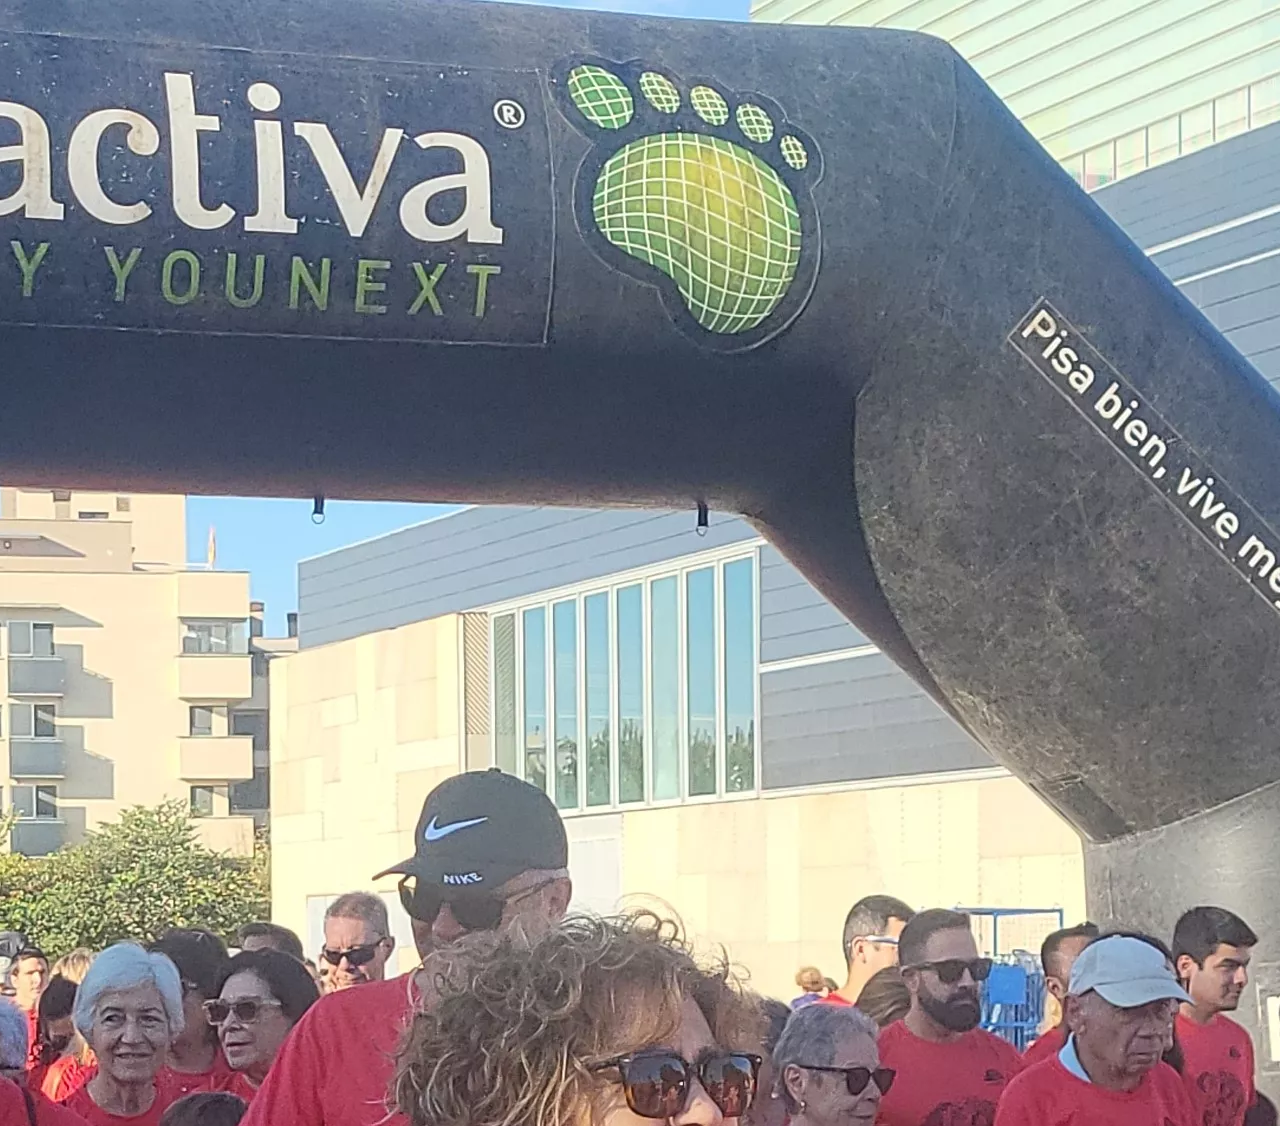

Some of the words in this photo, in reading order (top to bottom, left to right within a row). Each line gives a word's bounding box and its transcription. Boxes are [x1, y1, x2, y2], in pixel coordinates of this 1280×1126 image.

[106, 246, 502, 318] YOUNEXT
[1022, 309, 1095, 394] Pisa
[1094, 381, 1167, 479] bien,
[1176, 466, 1240, 539] vive
[443, 872, 483, 885] NIKE
